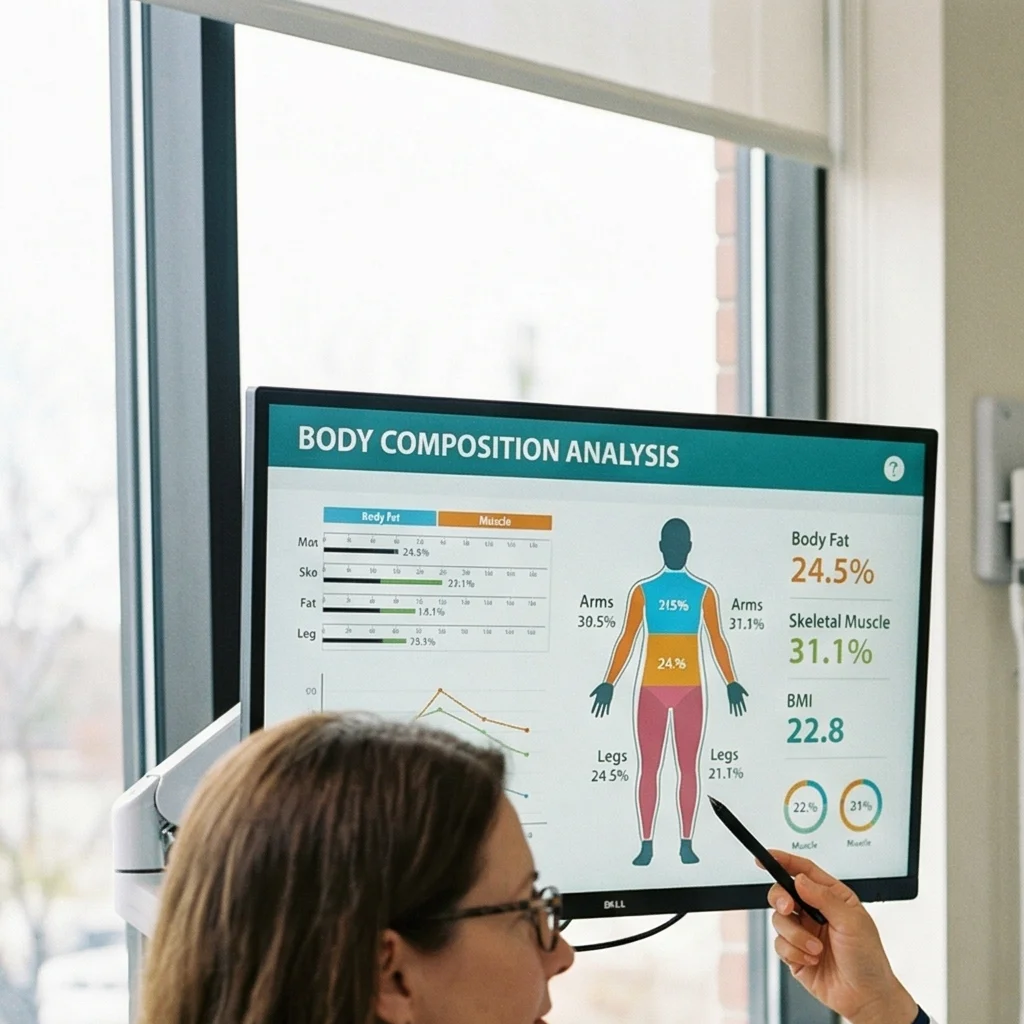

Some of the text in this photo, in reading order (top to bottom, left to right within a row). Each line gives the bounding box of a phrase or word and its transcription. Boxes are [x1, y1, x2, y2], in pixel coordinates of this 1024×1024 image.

[298, 425, 680, 468] BODY COMPOSITION ANALYSIS
[791, 531, 849, 550] Body Fat
[402, 547, 430, 557] 24.5%
[299, 566, 318, 577] Sko
[791, 557, 874, 584] 24.5%
[300, 598, 317, 608] Fat
[579, 594, 614, 609] Arms
[731, 598, 763, 611] Arms
[577, 615, 616, 628] 30.5%
[729, 617, 764, 630] 31.1%
[789, 613, 891, 629] Skeletal Muscle
[297, 628, 317, 641] Leg
[789, 637, 873, 664] 31.1%
[787, 694, 813, 708] BMI
[786, 717, 844, 743] 22.8
[597, 750, 627, 766] Legs
[710, 748, 739, 764] Legs
